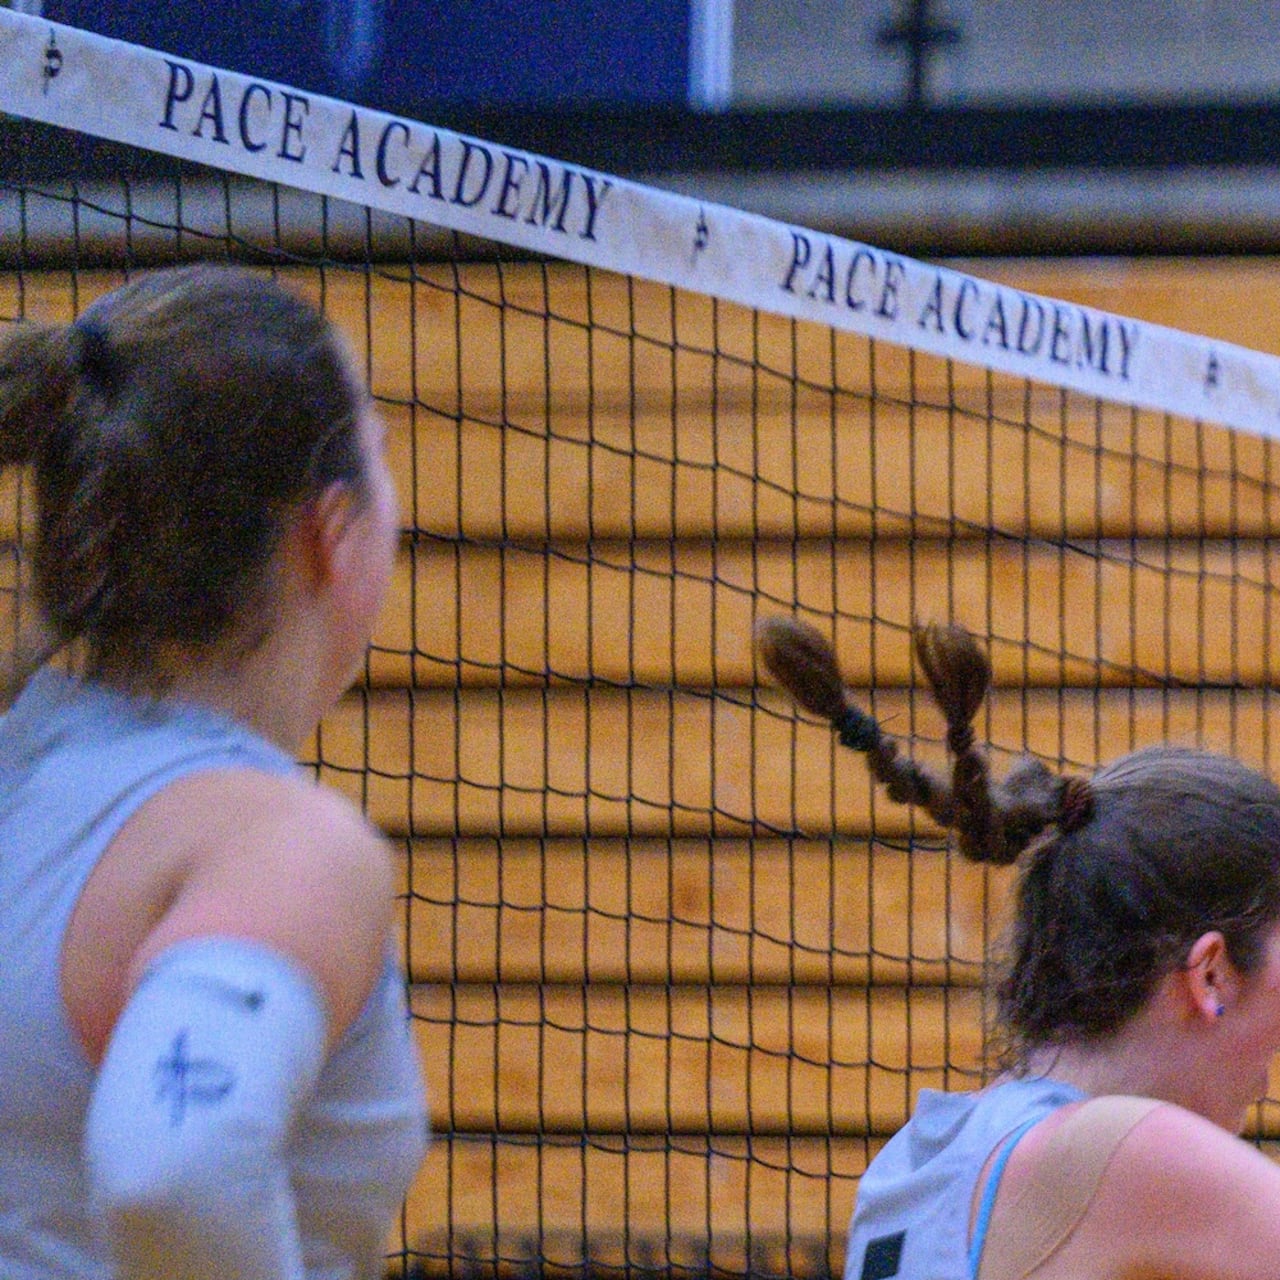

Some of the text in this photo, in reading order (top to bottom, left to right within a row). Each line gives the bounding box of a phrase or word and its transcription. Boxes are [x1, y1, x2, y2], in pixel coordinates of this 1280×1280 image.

[159, 59, 612, 242] PACE ACADEMY
[779, 231, 1140, 382] PACE ACADEMY
